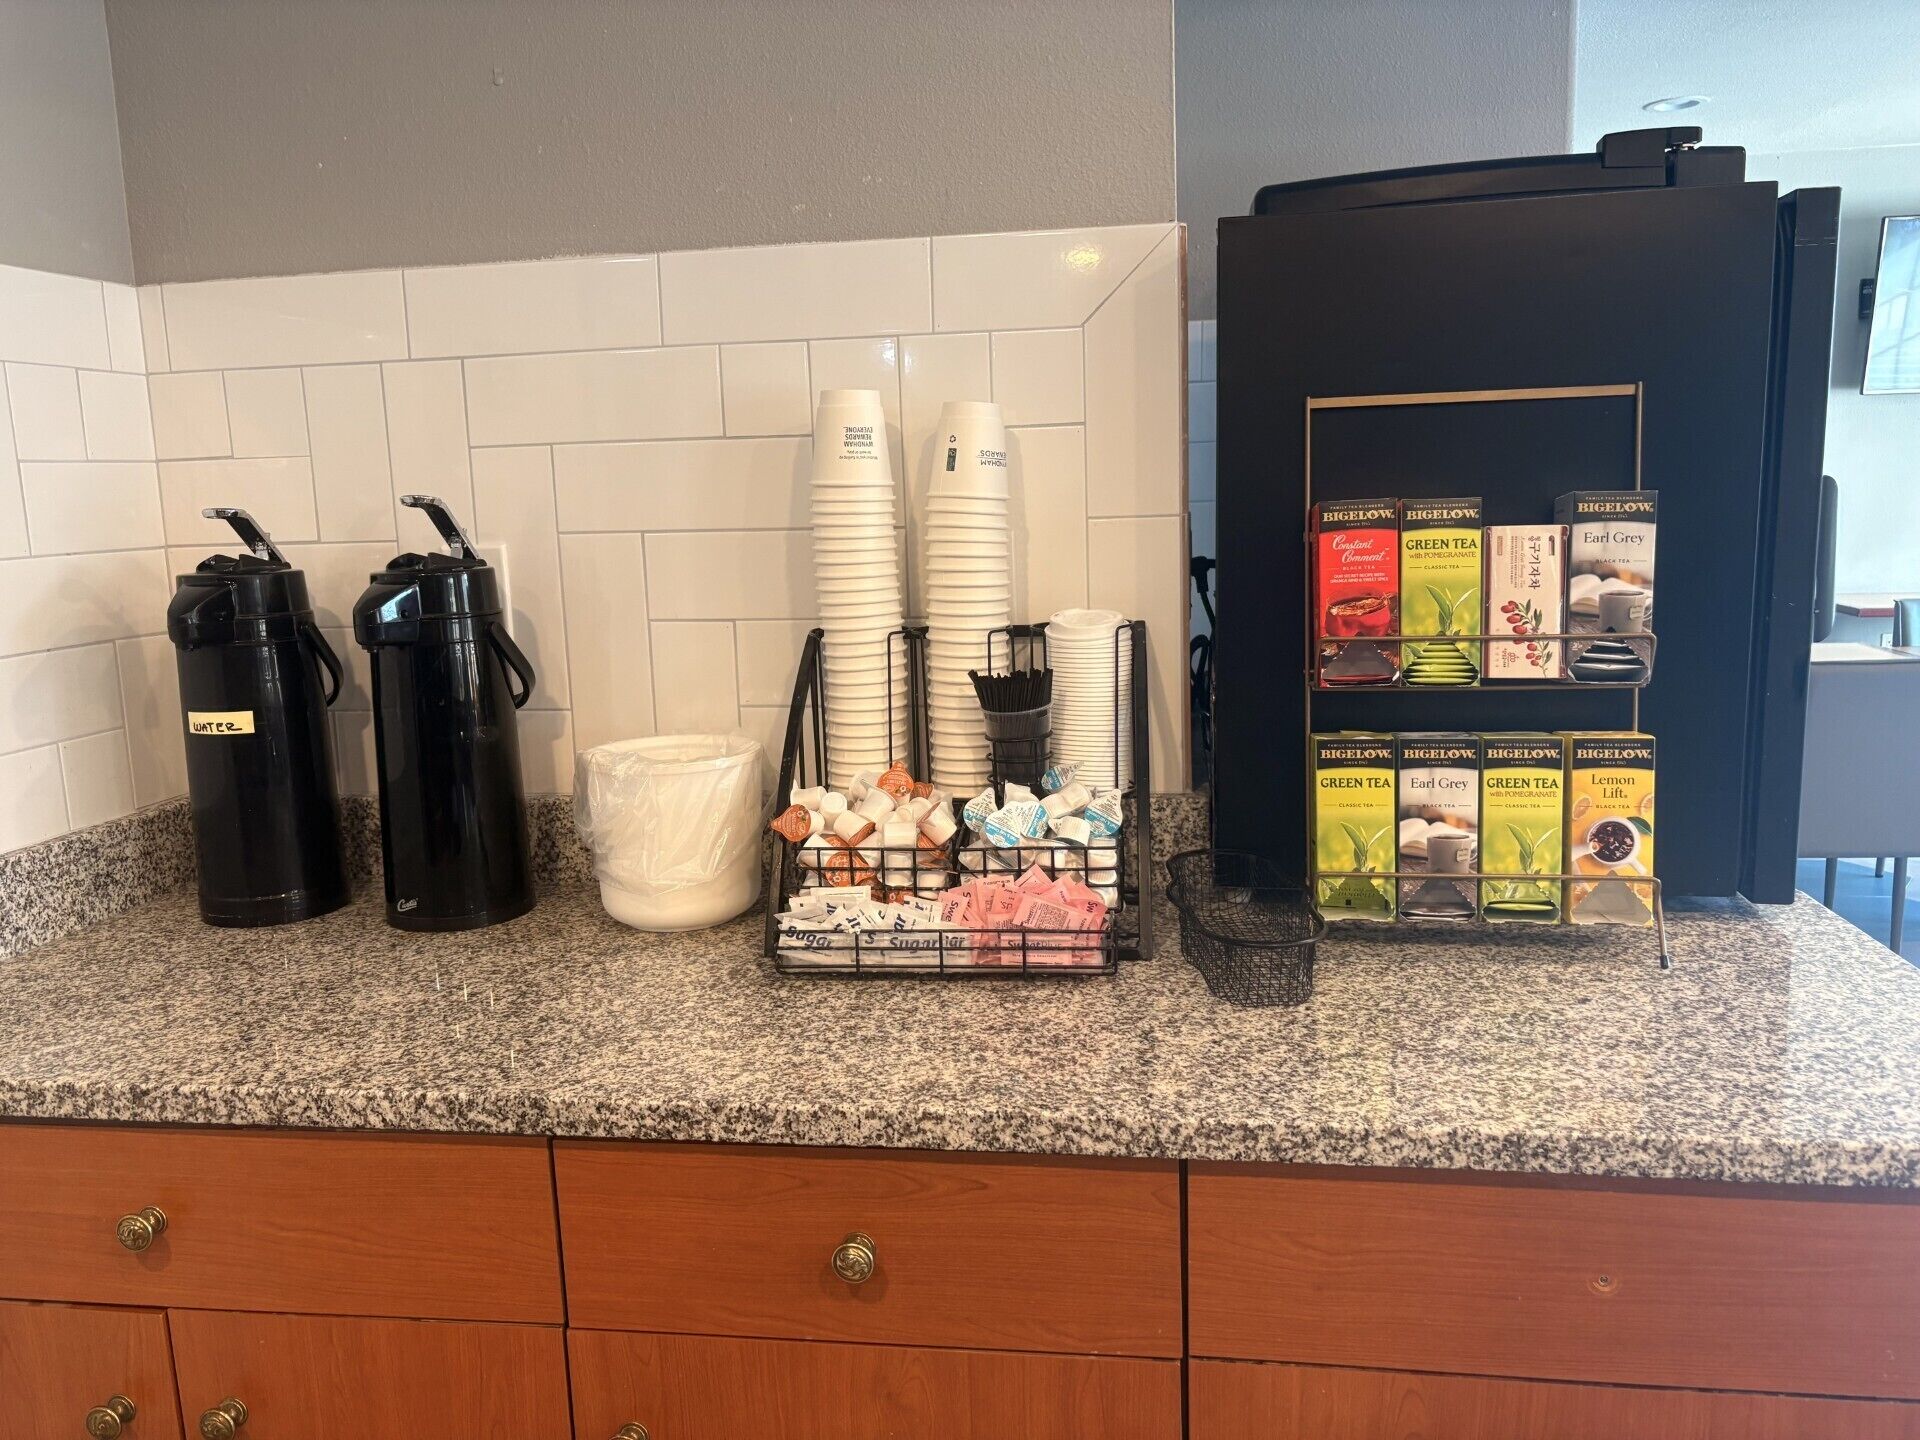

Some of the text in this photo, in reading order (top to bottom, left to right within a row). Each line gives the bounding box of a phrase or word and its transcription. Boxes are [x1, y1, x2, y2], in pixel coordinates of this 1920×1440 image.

[1576, 502, 1653, 512] BIGELOW
[1322, 509, 1394, 522] BIGELOW
[1406, 509, 1479, 520] BIGELOW
[1406, 538, 1478, 550] GREEN TEA
[1584, 532, 1644, 546] Earl Grey
[1528, 542, 1541, 590] 구기자차
[193, 722, 242, 733] WATER
[1320, 749, 1392, 759] BIGELOW
[1403, 749, 1476, 759] BIGELOW
[1486, 749, 1560, 759] BIGELOW
[1576, 749, 1651, 759] BIGELOW
[1321, 778, 1391, 788] GREEN TEA
[1411, 778, 1468, 791] Earl Grey
[1487, 778, 1559, 788] GREEN TEA
[1592, 774, 1635, 785] Lemon
